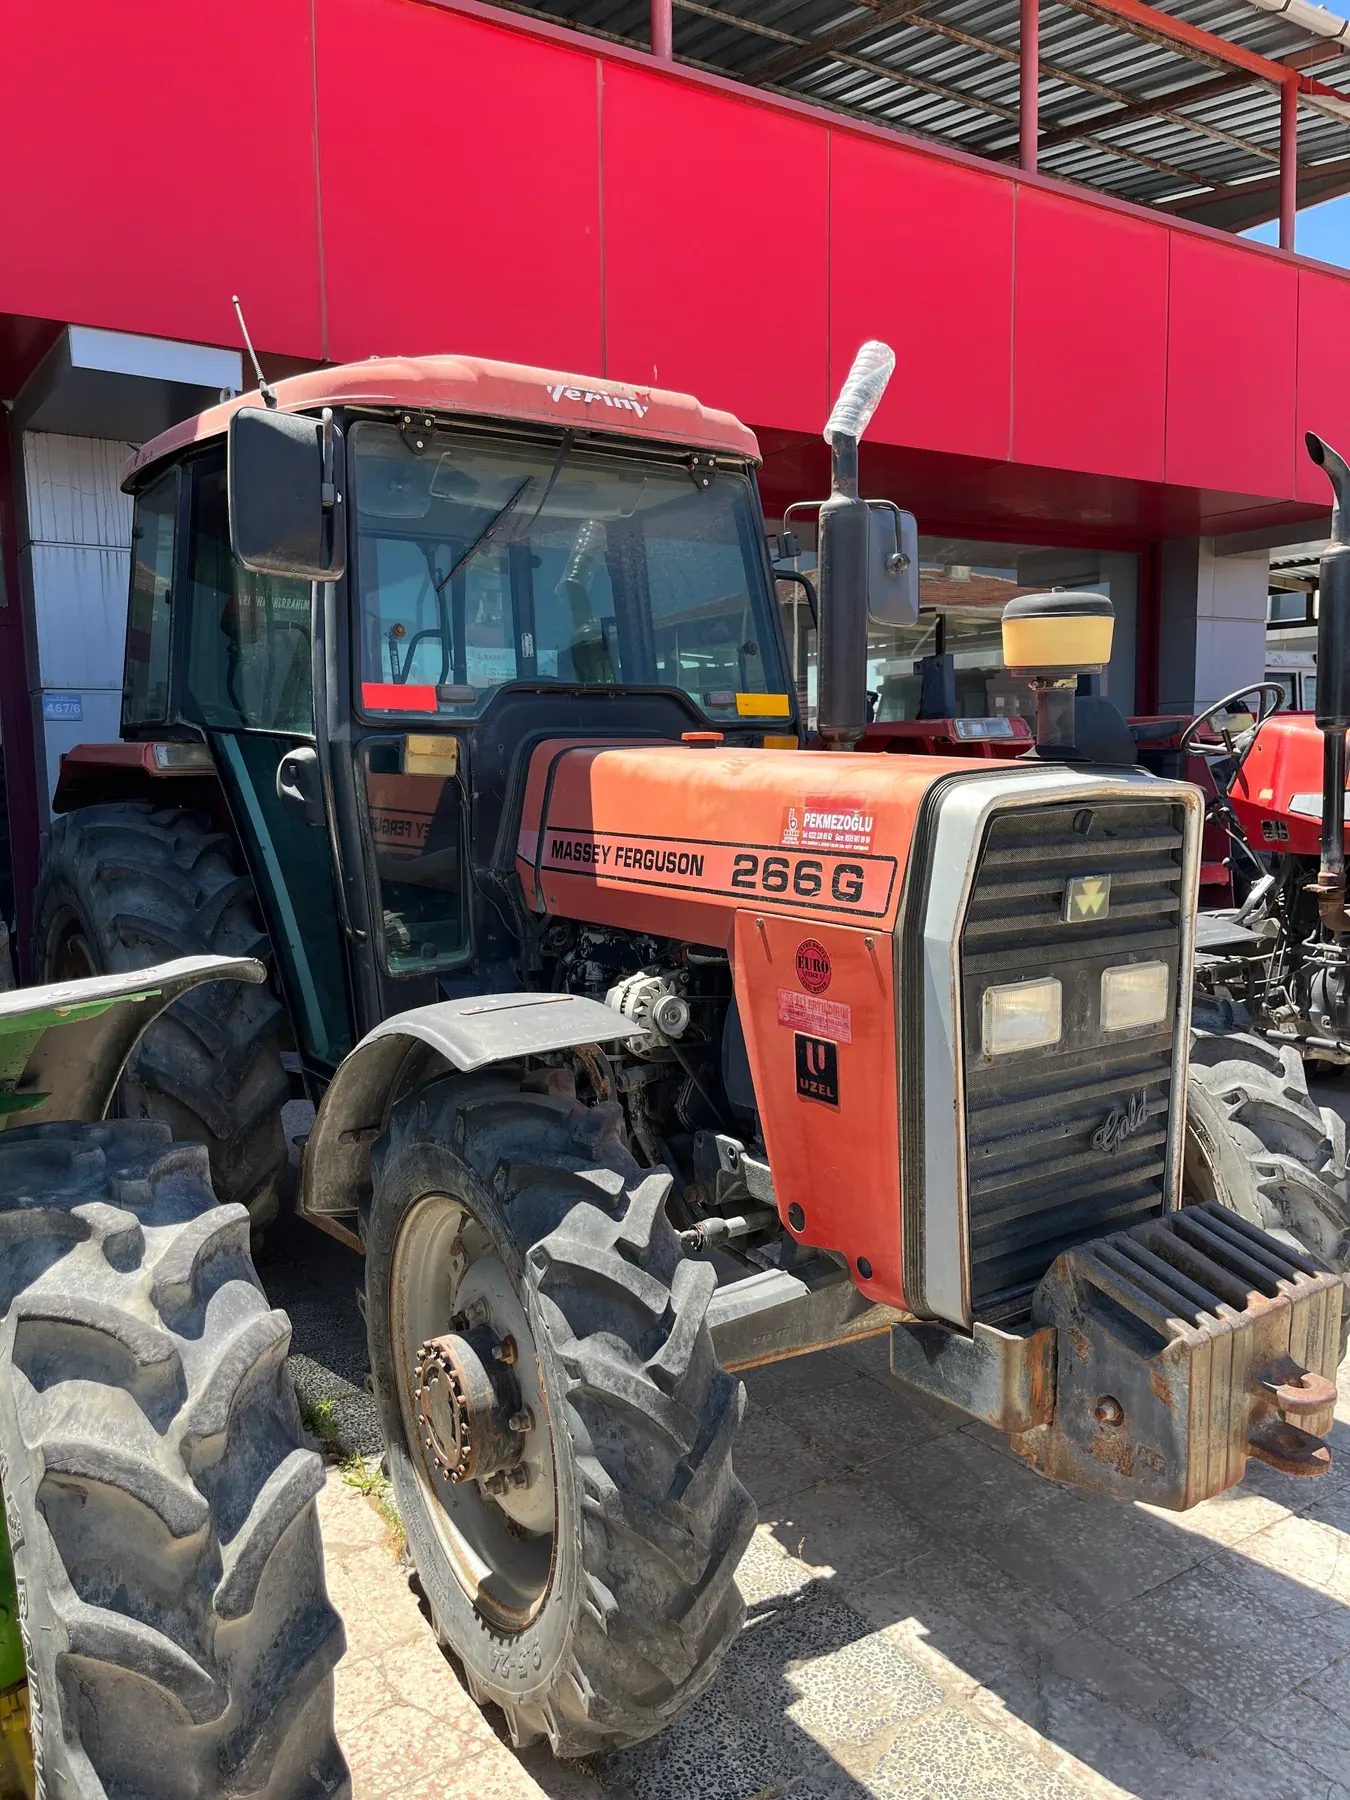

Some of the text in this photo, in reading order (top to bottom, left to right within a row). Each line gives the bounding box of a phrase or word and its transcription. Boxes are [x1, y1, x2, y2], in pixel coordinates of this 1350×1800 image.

[46, 703, 80, 714] 467/6
[803, 812, 873, 832] PEKMEZOĞLU
[551, 839, 705, 877] MASSEY FERGUSON
[797, 956, 829, 974] EURO
[800, 1077, 834, 1098] UZEL
[1090, 1087, 1148, 1158] Gold
